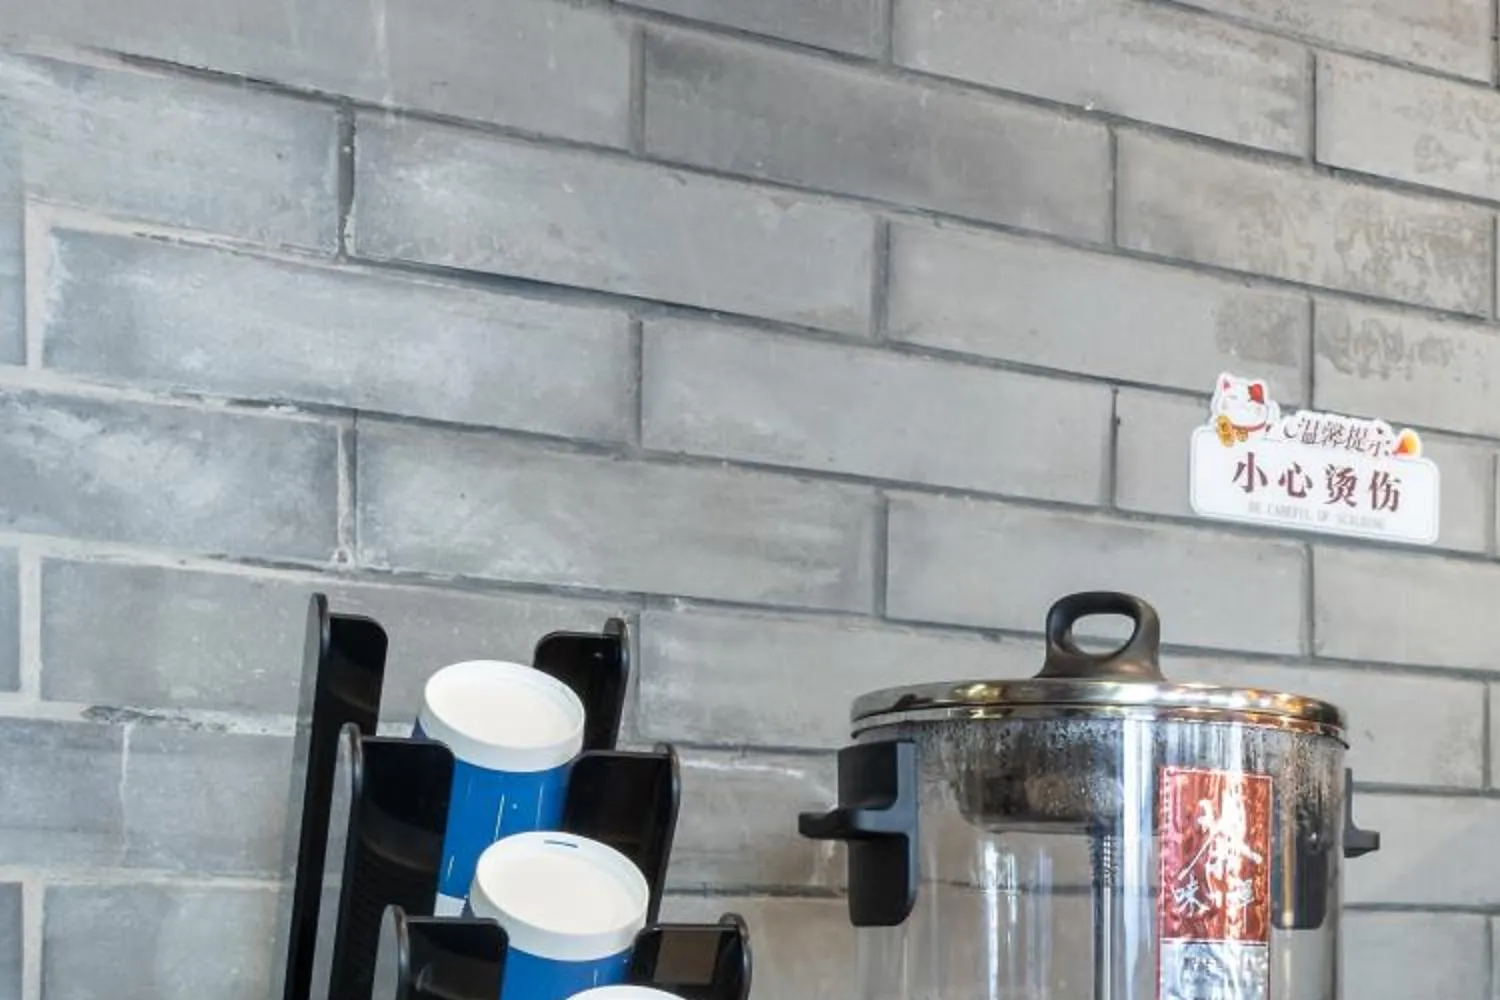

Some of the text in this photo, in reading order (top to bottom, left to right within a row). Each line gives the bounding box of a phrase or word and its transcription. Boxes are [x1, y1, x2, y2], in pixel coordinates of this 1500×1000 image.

[1298, 417, 1392, 457] 温馨提示
[1232, 451, 1402, 513] 小心烫伤
